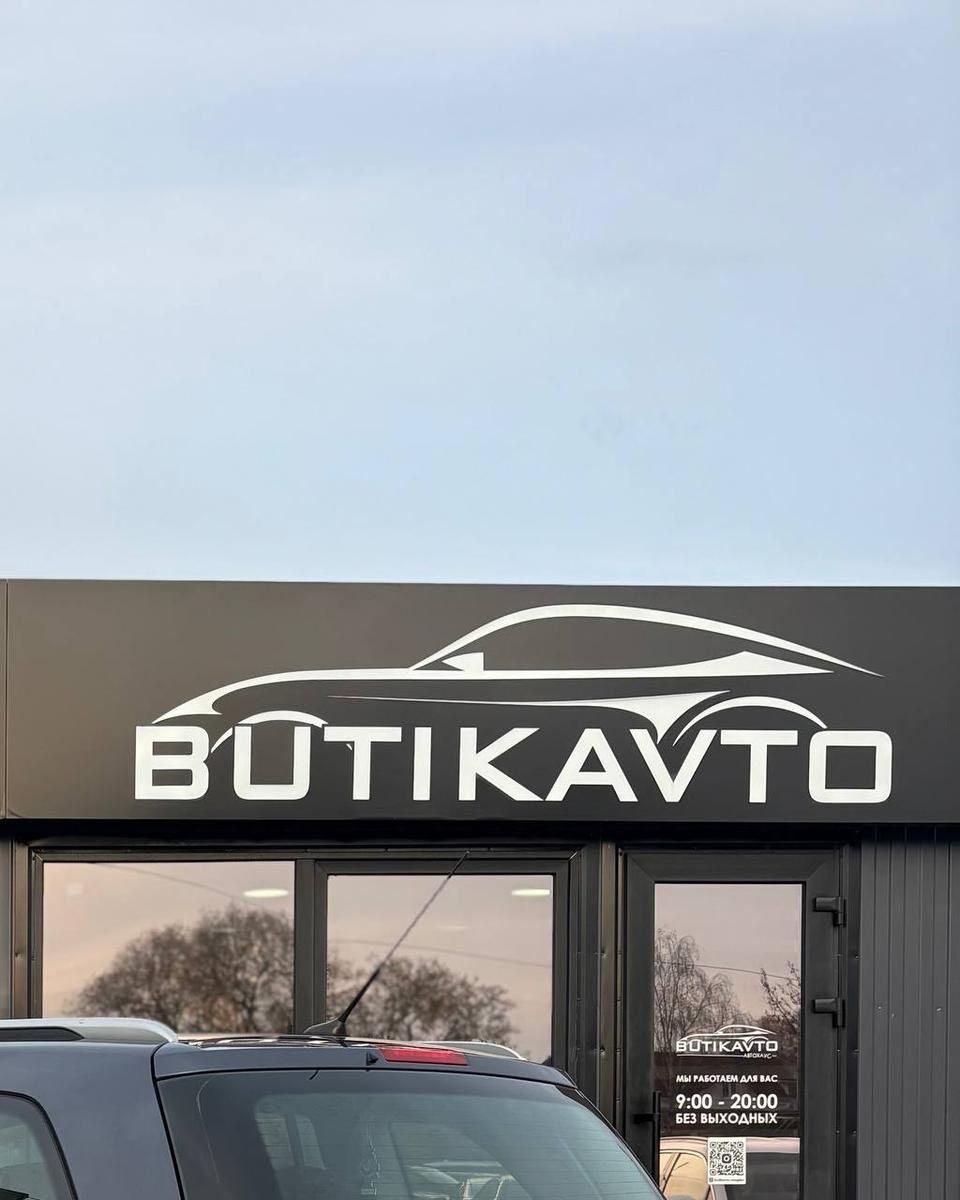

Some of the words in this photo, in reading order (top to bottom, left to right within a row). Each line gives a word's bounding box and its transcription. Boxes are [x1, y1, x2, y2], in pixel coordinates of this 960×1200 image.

[135, 725, 893, 804] BUTIKAVTO
[675, 1041, 778, 1053] BUTIKAVTO
[676, 1075, 692, 1083] МЫ
[693, 1075, 738, 1083] РАБОТАЕМ
[740, 1075, 758, 1083] ДЛЯ
[760, 1075, 778, 1083] ВАС
[676, 1094, 713, 1109] 9:00
[730, 1094, 778, 1109] 20:00
[676, 1113, 697, 1124] БЕЗ
[700, 1113, 778, 1125] ВЫХОДНЫХ
